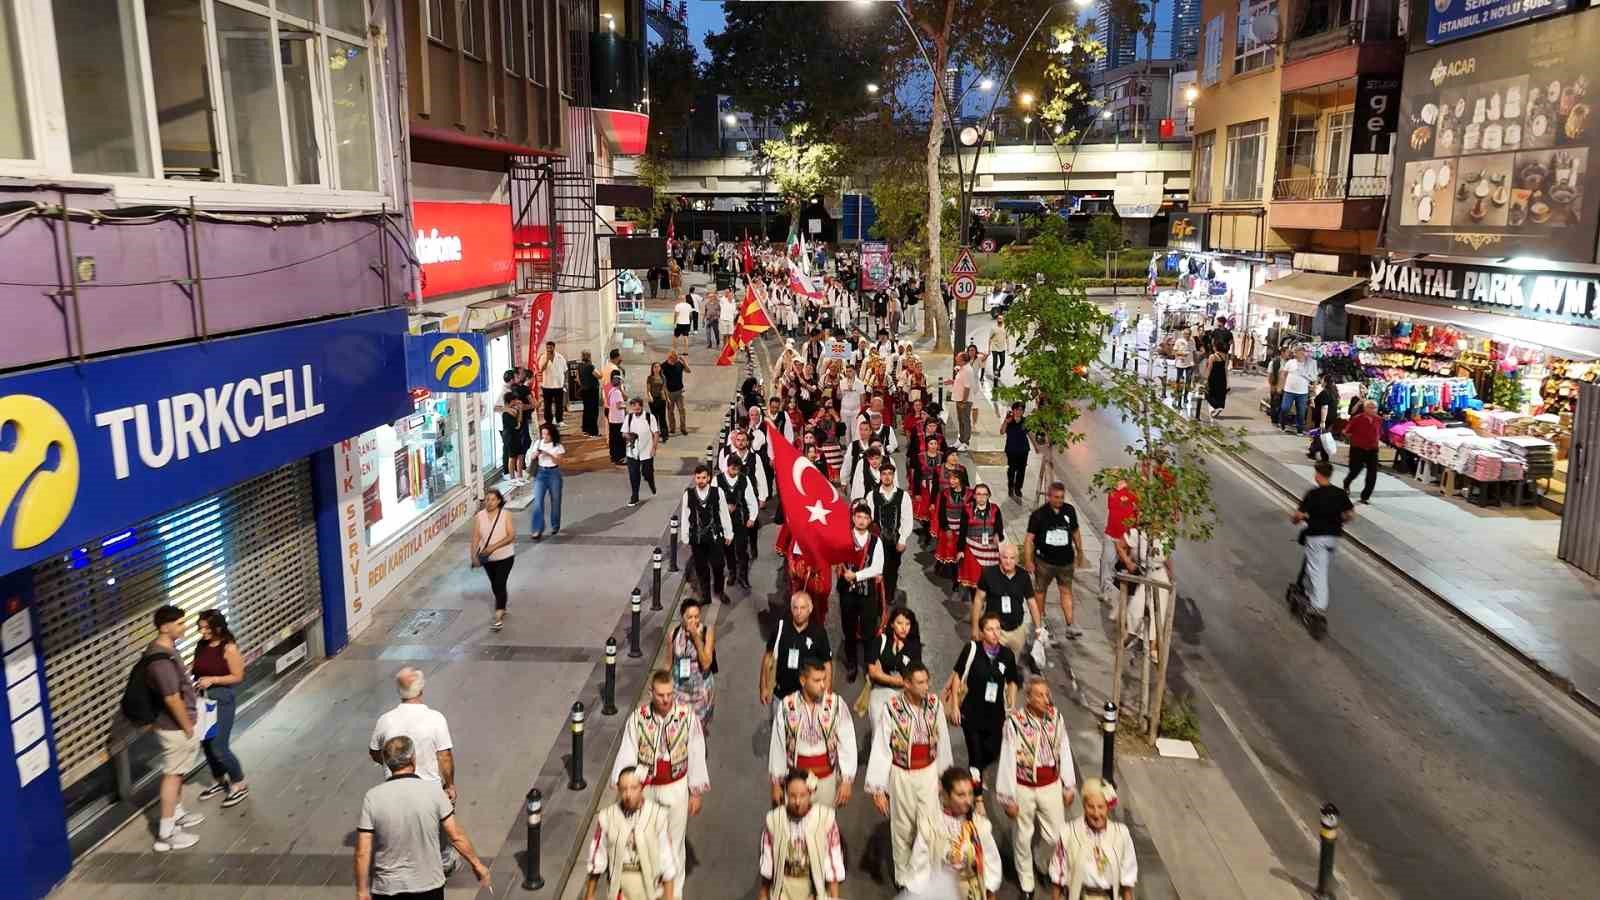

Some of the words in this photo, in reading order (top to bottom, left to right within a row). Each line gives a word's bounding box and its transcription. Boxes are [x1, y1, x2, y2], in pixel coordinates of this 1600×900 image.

[1438, 13, 1480, 33] İSTANBUL
[1482, 11, 1488, 22] 2
[1446, 57, 1476, 78] ACAR
[958, 281, 972, 294] 30
[1384, 263, 1457, 299] KARTAL
[1463, 271, 1523, 307] PARK
[1528, 275, 1588, 315] AVM
[94, 364, 326, 480] TURKCELL
[346, 503, 363, 614] SERVİS
